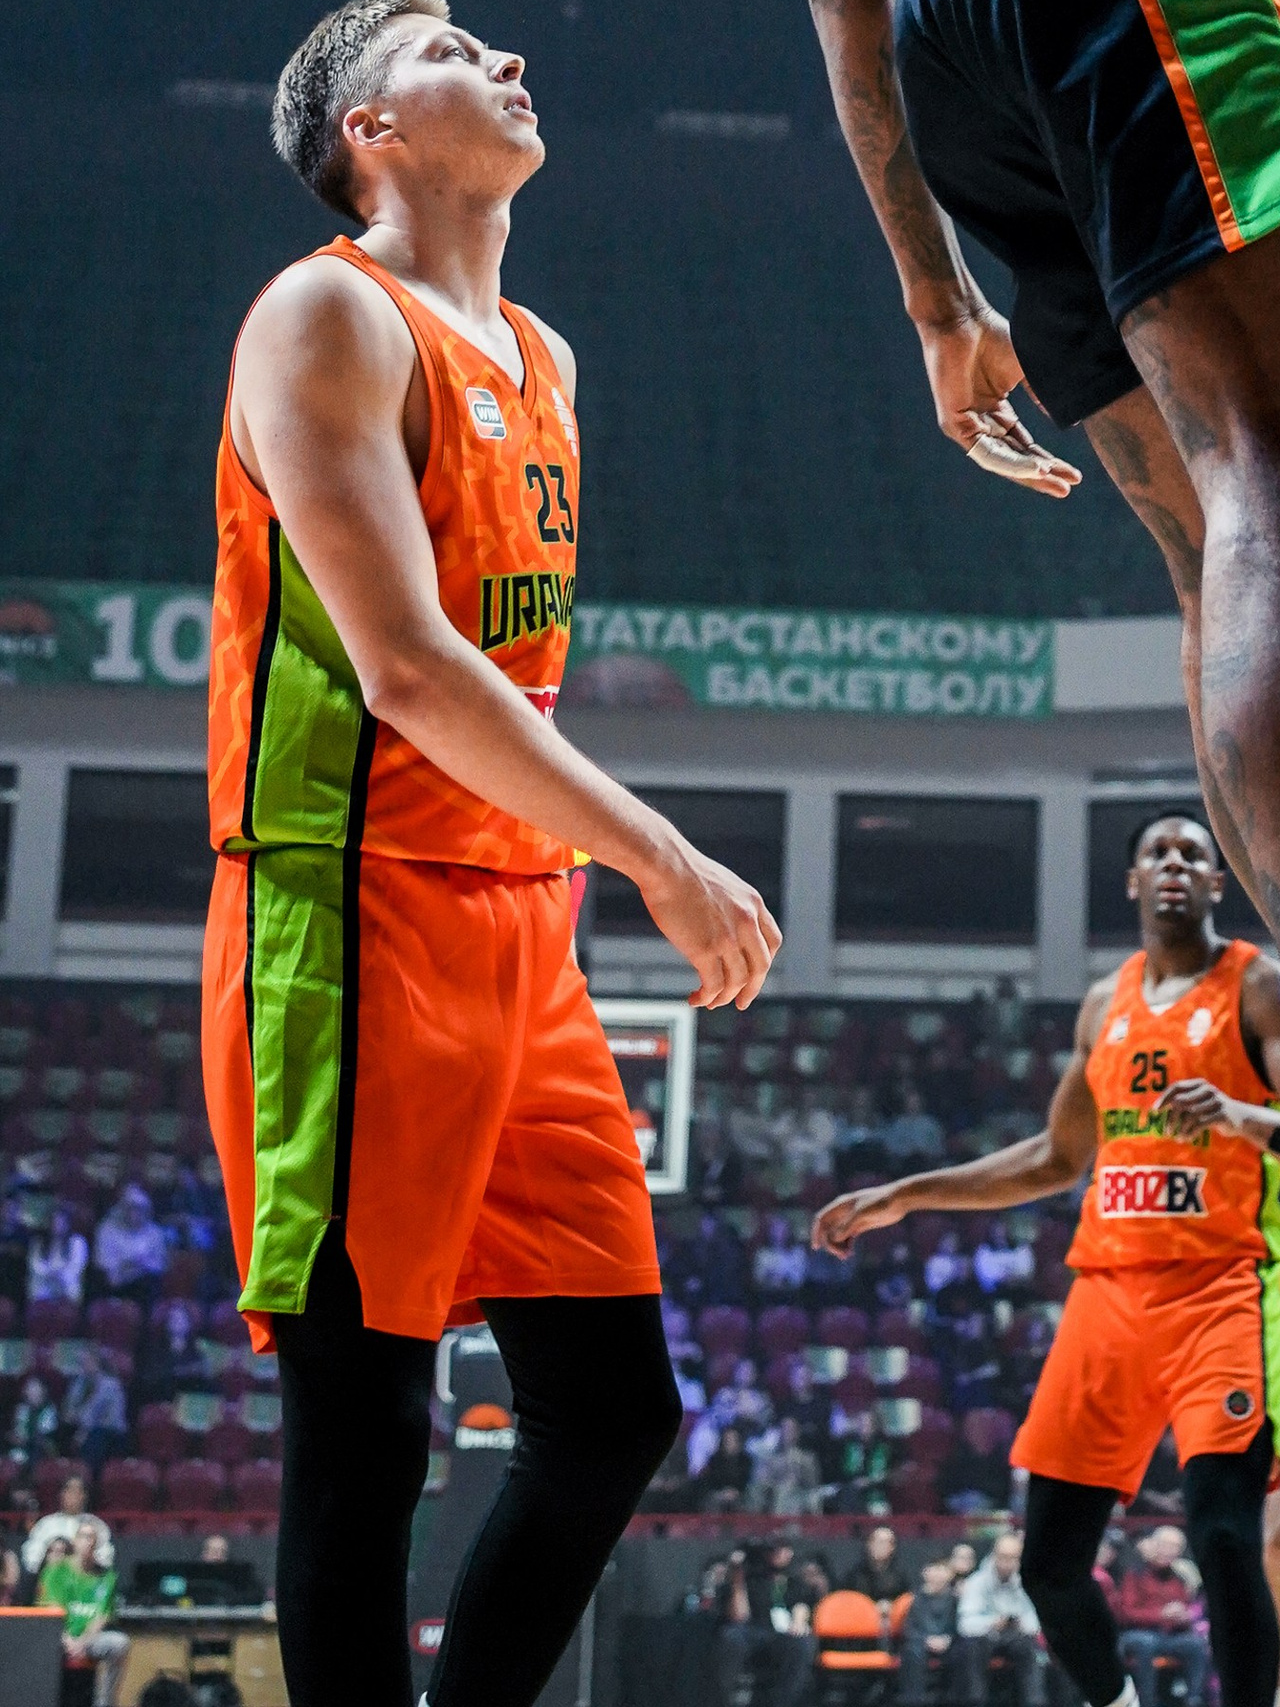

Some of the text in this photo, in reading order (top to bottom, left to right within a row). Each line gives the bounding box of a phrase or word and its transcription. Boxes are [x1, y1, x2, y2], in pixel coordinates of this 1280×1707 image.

[475, 404, 501, 424] WIN
[525, 463, 575, 544] 23
[573, 606, 1045, 663] ТАТАРСТАНСКОМУ
[706, 662, 1046, 715] БАСКЕТБОЛУ
[1130, 1050, 1168, 1093] 25
[1103, 1170, 1204, 1213] BROZEX
